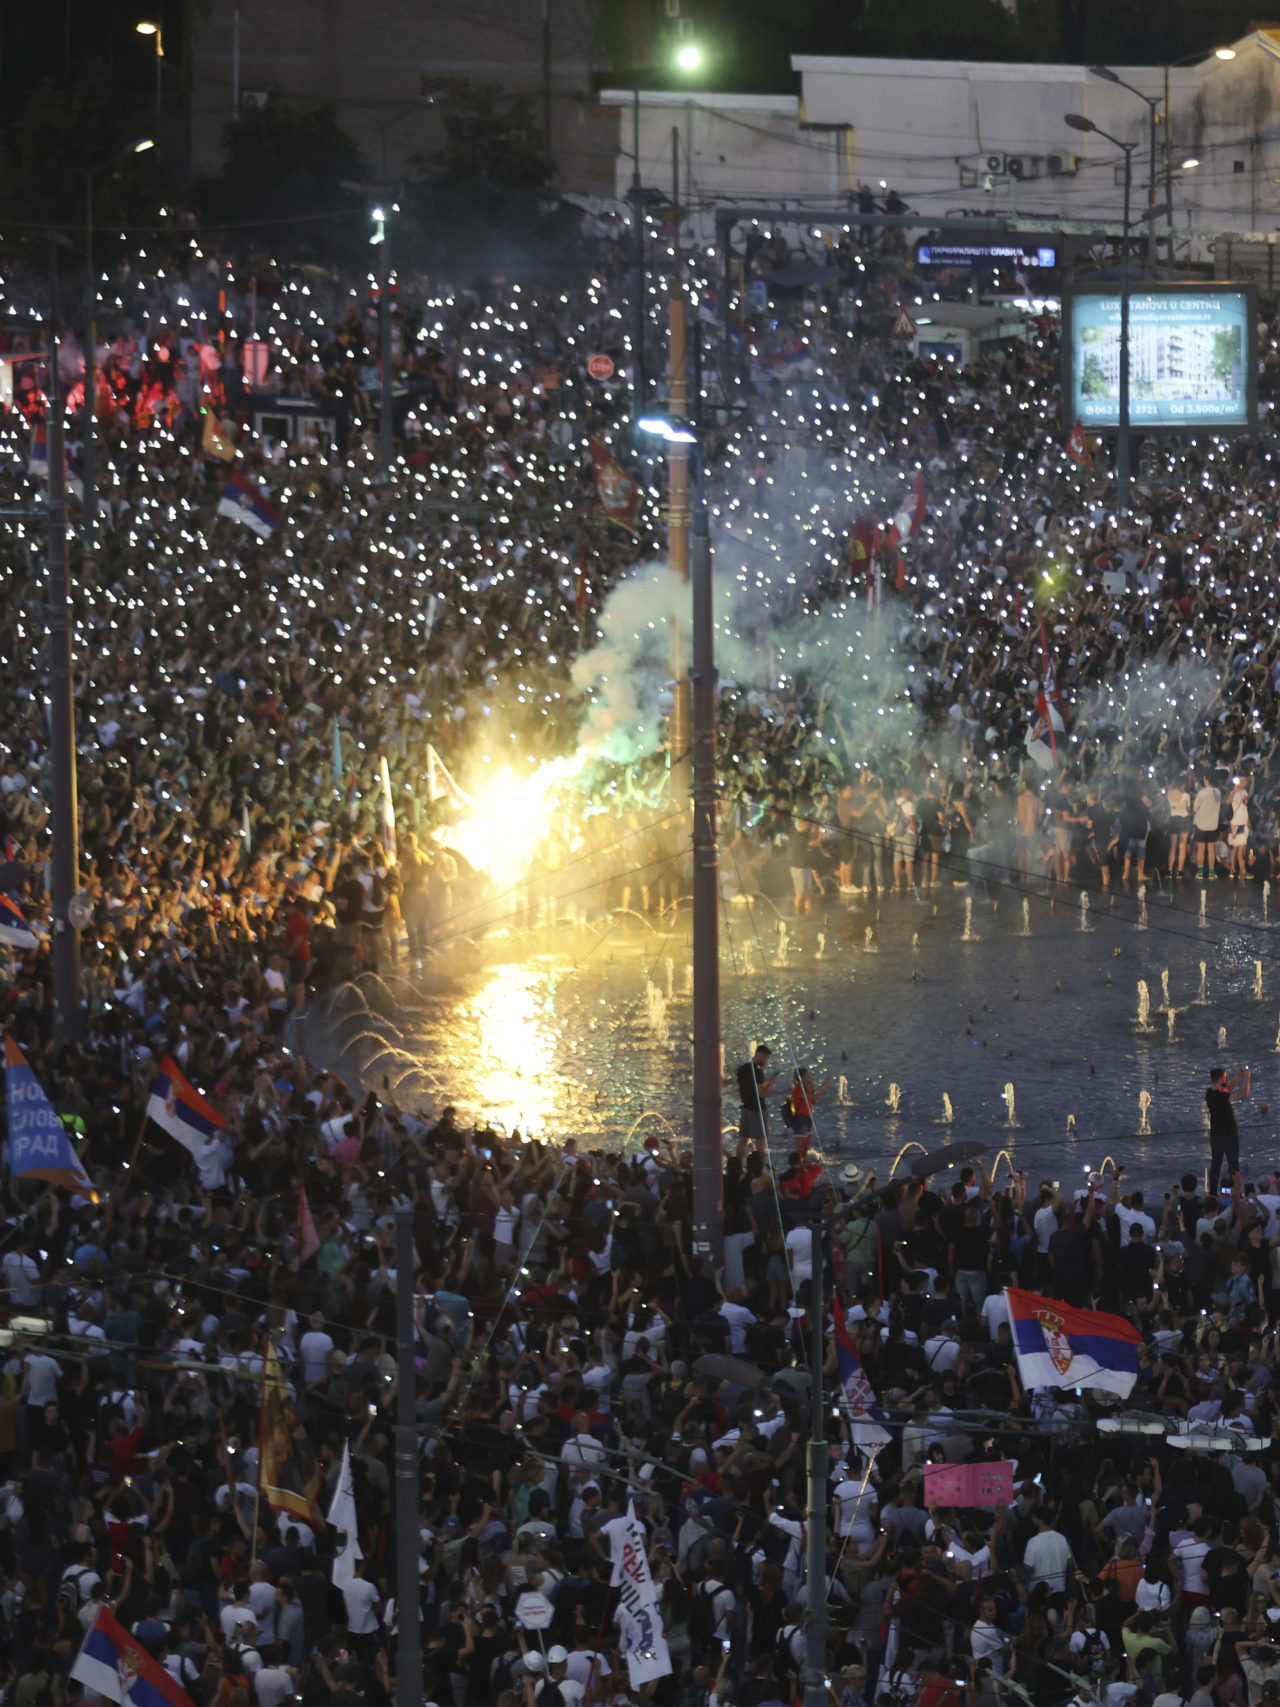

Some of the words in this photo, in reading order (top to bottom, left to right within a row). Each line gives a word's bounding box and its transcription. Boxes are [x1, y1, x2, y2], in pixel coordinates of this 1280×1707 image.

[931, 247, 989, 256] ПАРКИРАЛИШТЕ
[991, 247, 1025, 257] СЛАВИЈА
[1100, 301, 1121, 310] LUX
[1129, 301, 1168, 310] TANOVI
[1170, 301, 1178, 310] U
[1180, 301, 1220, 311] CENTRU
[1170, 404, 1184, 414] Od
[14, 1134, 59, 1162] РАД
